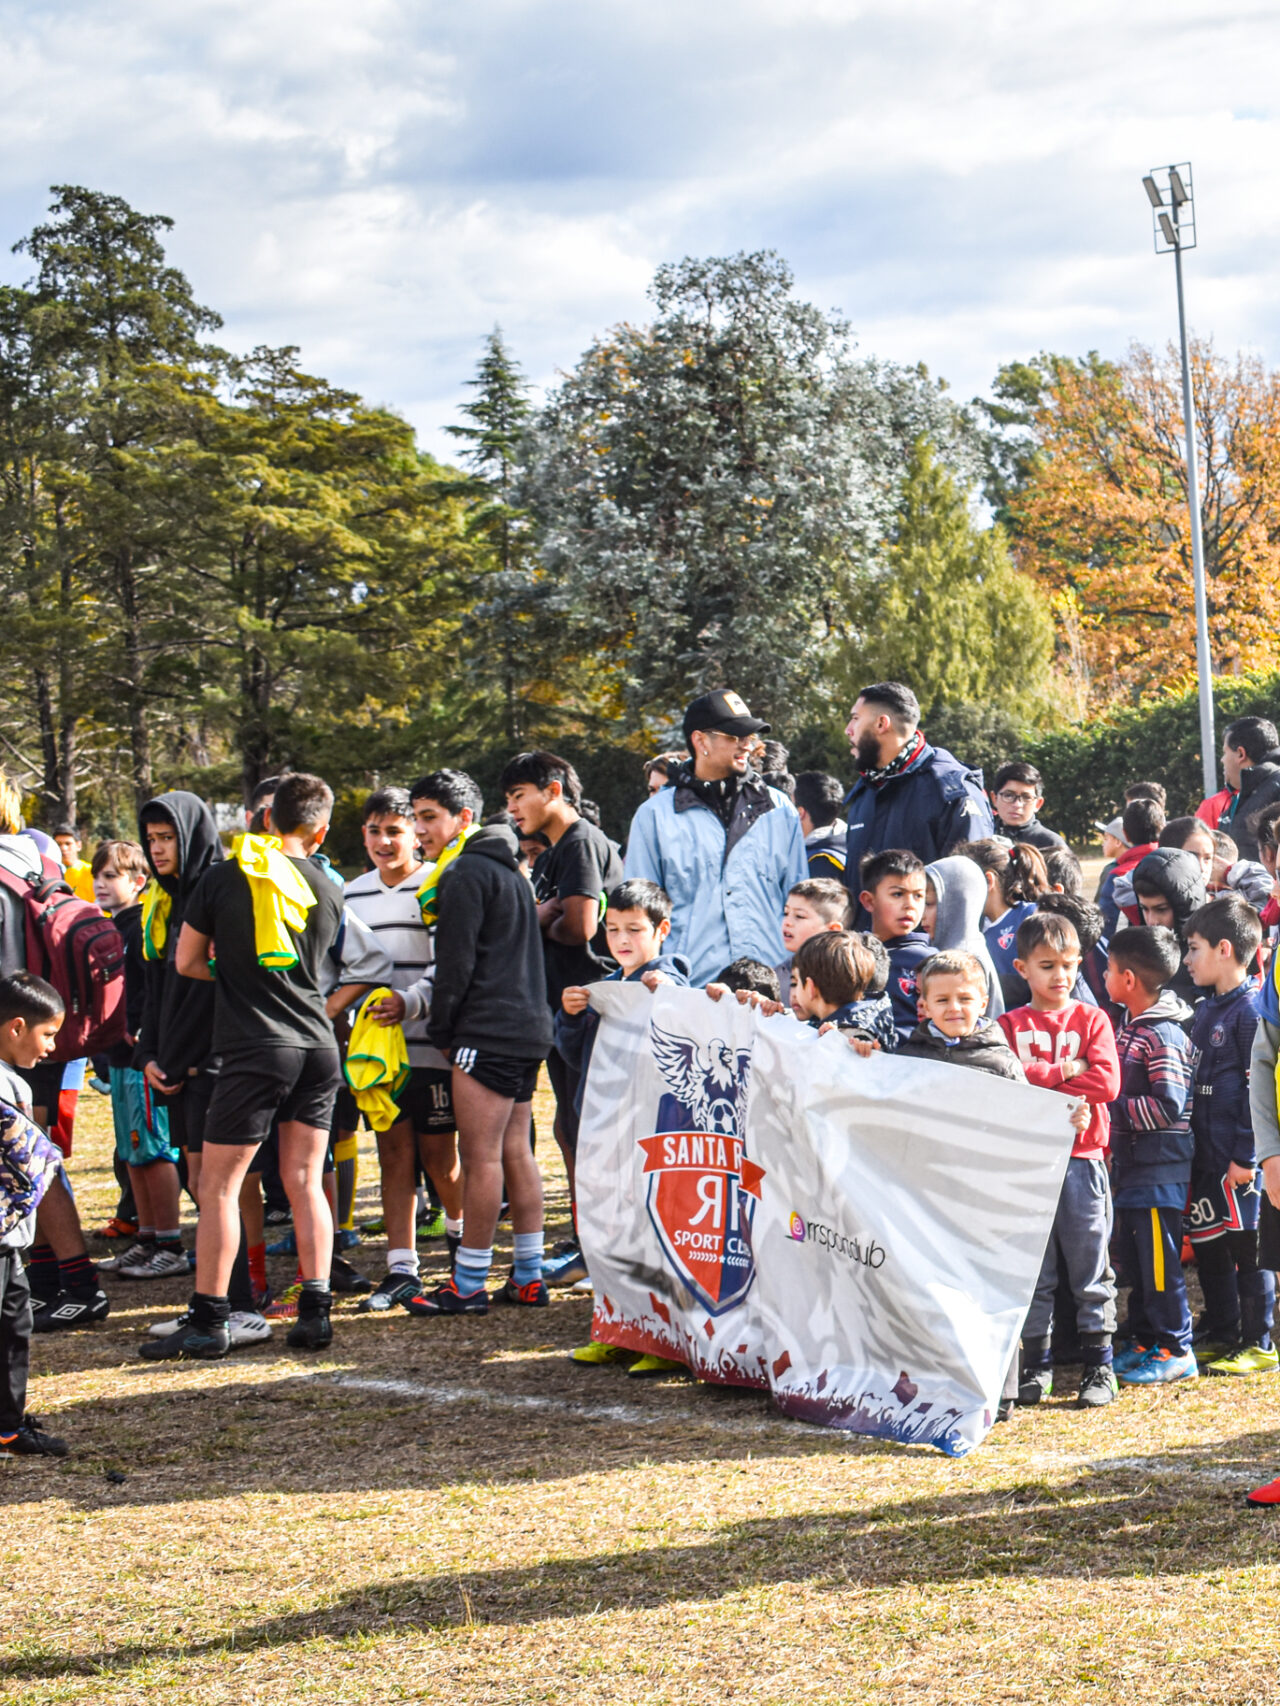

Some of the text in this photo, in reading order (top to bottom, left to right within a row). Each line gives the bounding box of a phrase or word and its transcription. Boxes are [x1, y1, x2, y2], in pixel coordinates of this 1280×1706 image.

[429, 1083, 449, 1109] 16
[662, 1136, 728, 1167] SANTA
[1190, 1197, 1215, 1225] 30
[673, 1230, 723, 1251] SPORT
